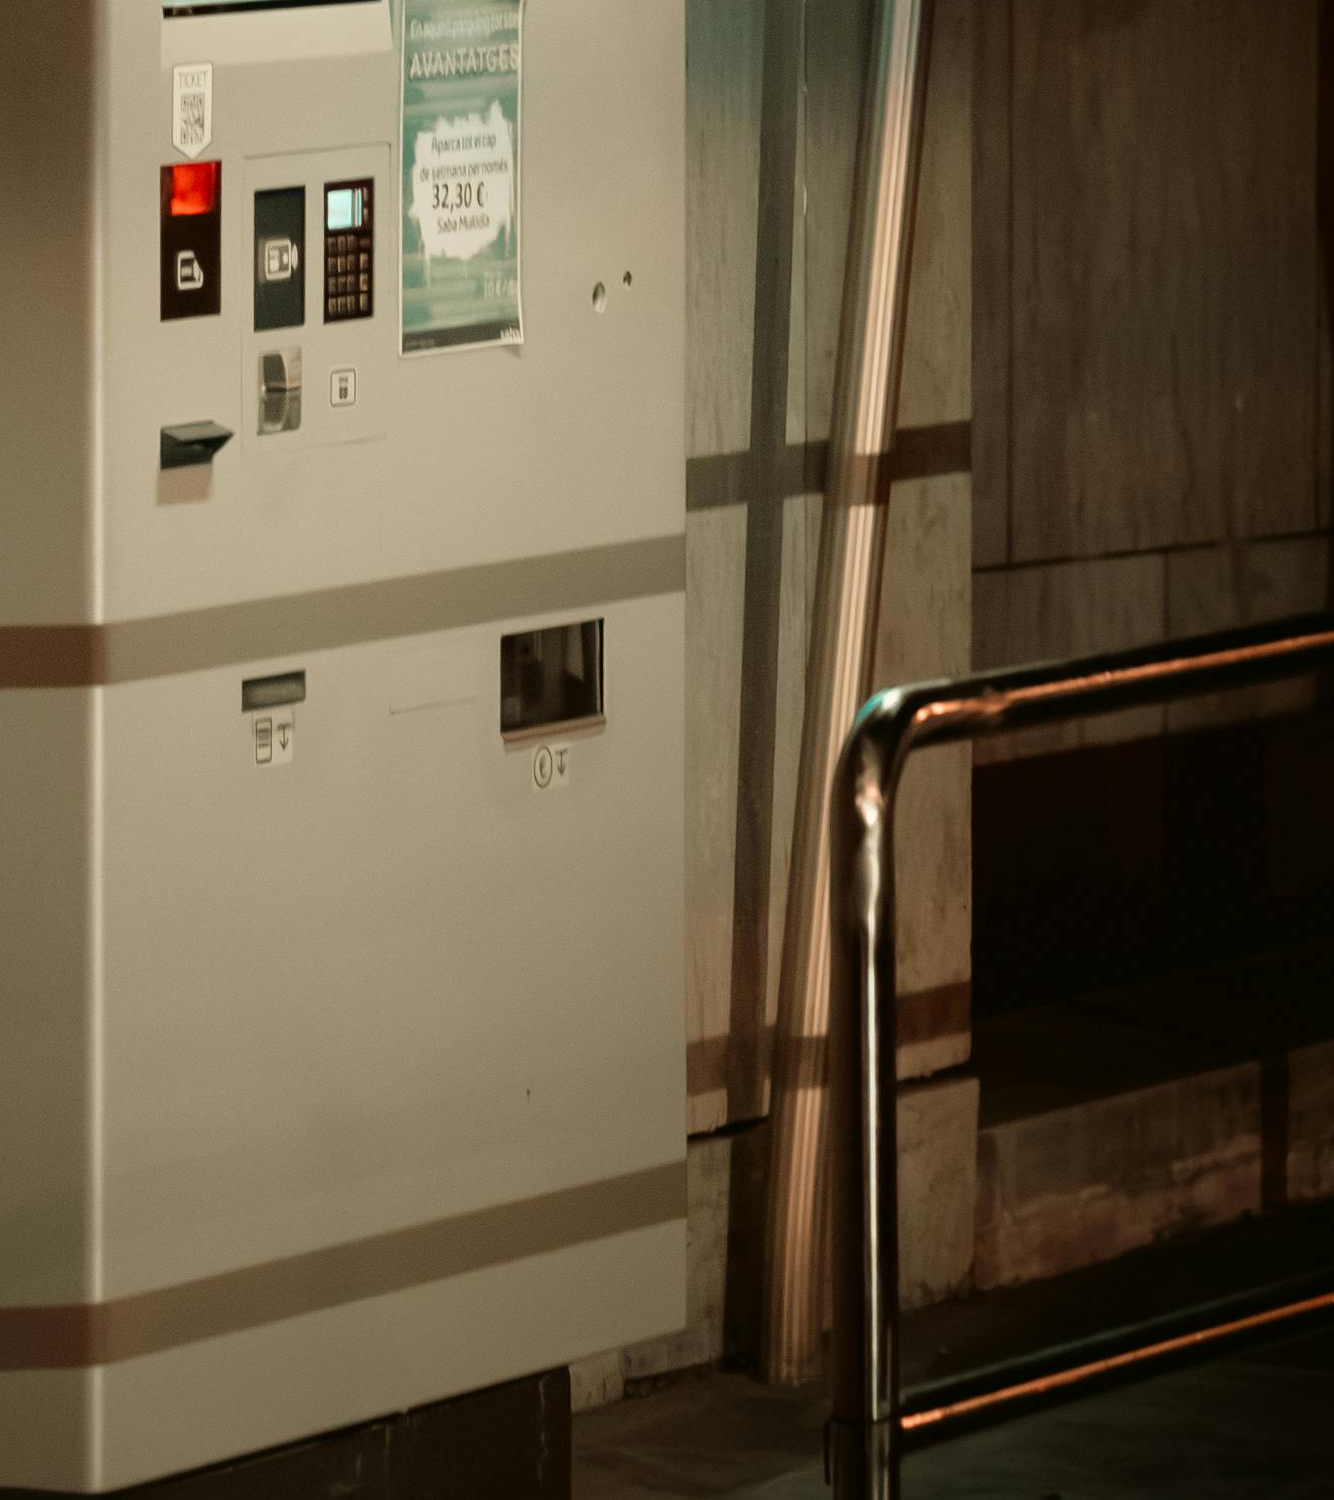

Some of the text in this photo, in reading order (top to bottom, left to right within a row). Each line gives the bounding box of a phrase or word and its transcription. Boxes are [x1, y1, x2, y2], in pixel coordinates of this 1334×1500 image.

[410, 44, 519, 79] AVANTATGES
[178, 70, 208, 89] TICKET
[431, 135, 461, 157] Aparca
[482, 133, 497, 152] cap
[432, 182, 473, 214] 32,30
